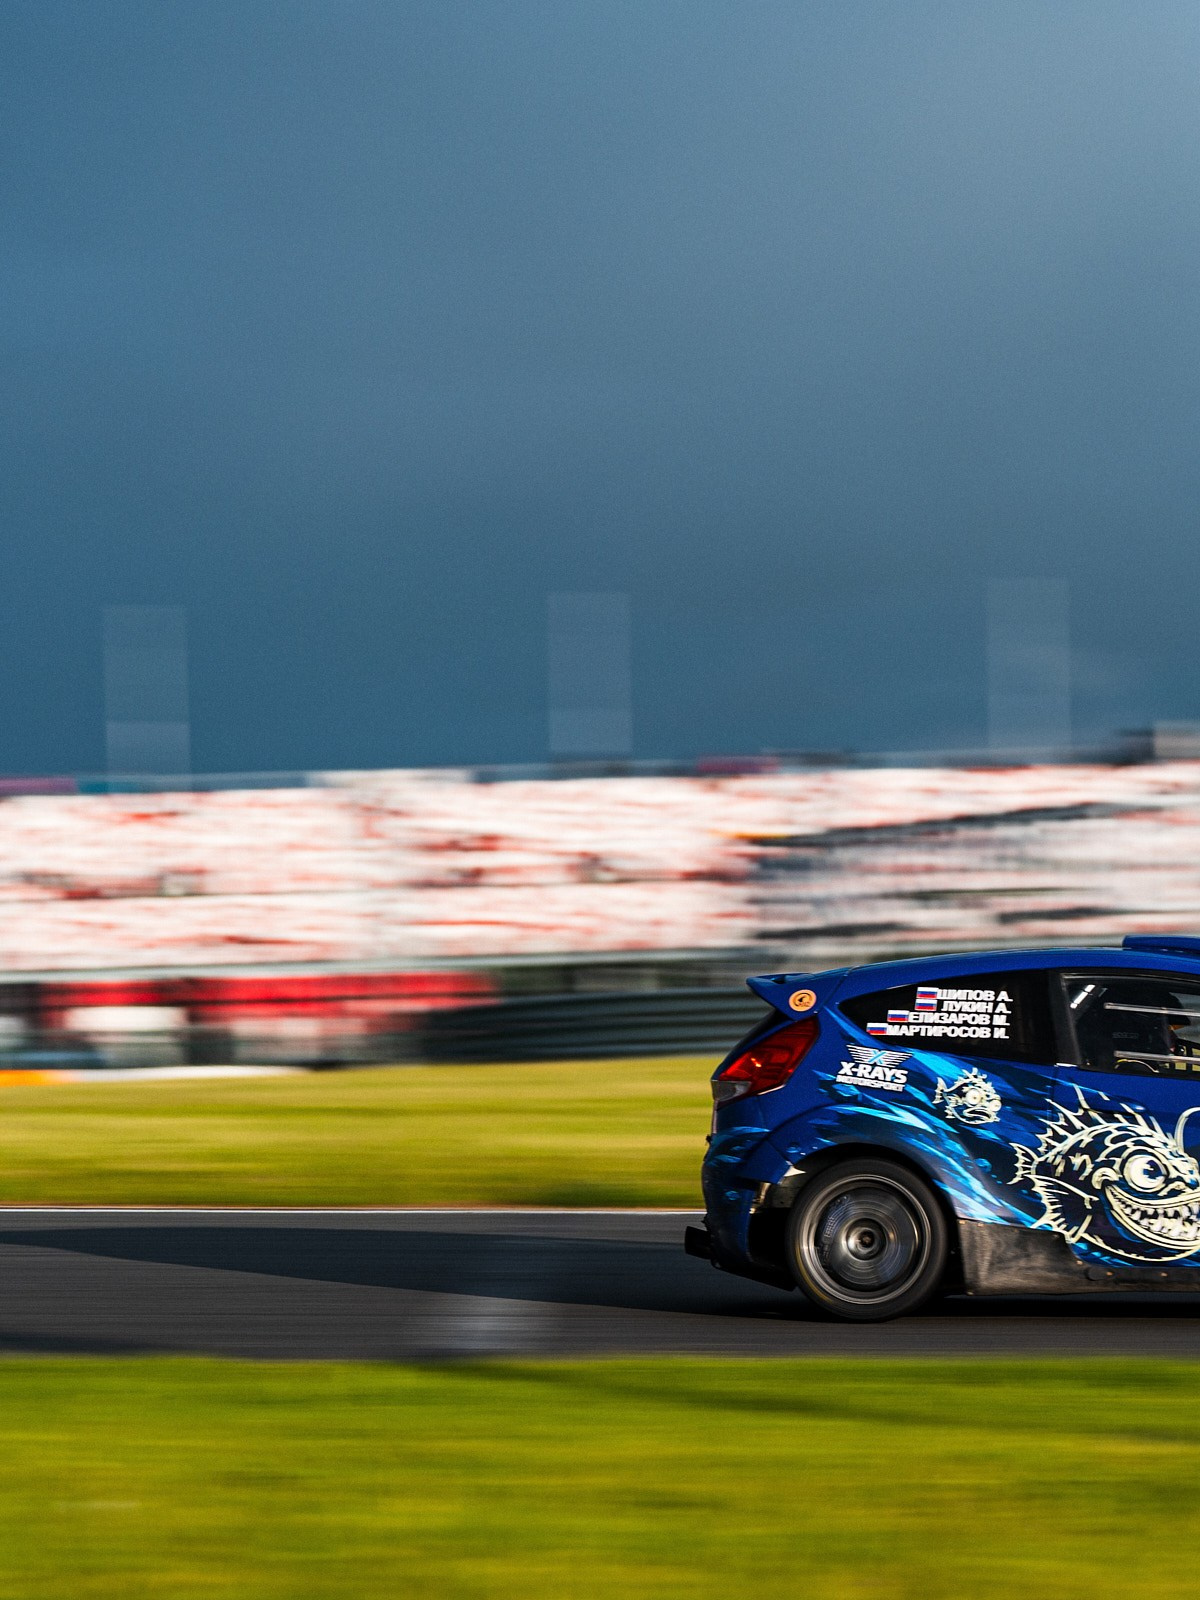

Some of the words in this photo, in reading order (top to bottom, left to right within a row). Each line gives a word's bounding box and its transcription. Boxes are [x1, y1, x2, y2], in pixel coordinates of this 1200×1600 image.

[937, 989, 995, 1001] ШИПОВ
[996, 991, 1013, 1002] А.
[941, 1001, 993, 1013] ЛУКИН
[994, 1002, 1011, 1014] А.
[908, 1012, 991, 1025] ЕЛИЗАРОВ
[886, 1024, 991, 1039] МАРТИРОСОВ
[838, 1061, 909, 1084] X-RAYS
[835, 1074, 906, 1092] MOTORSPORT
